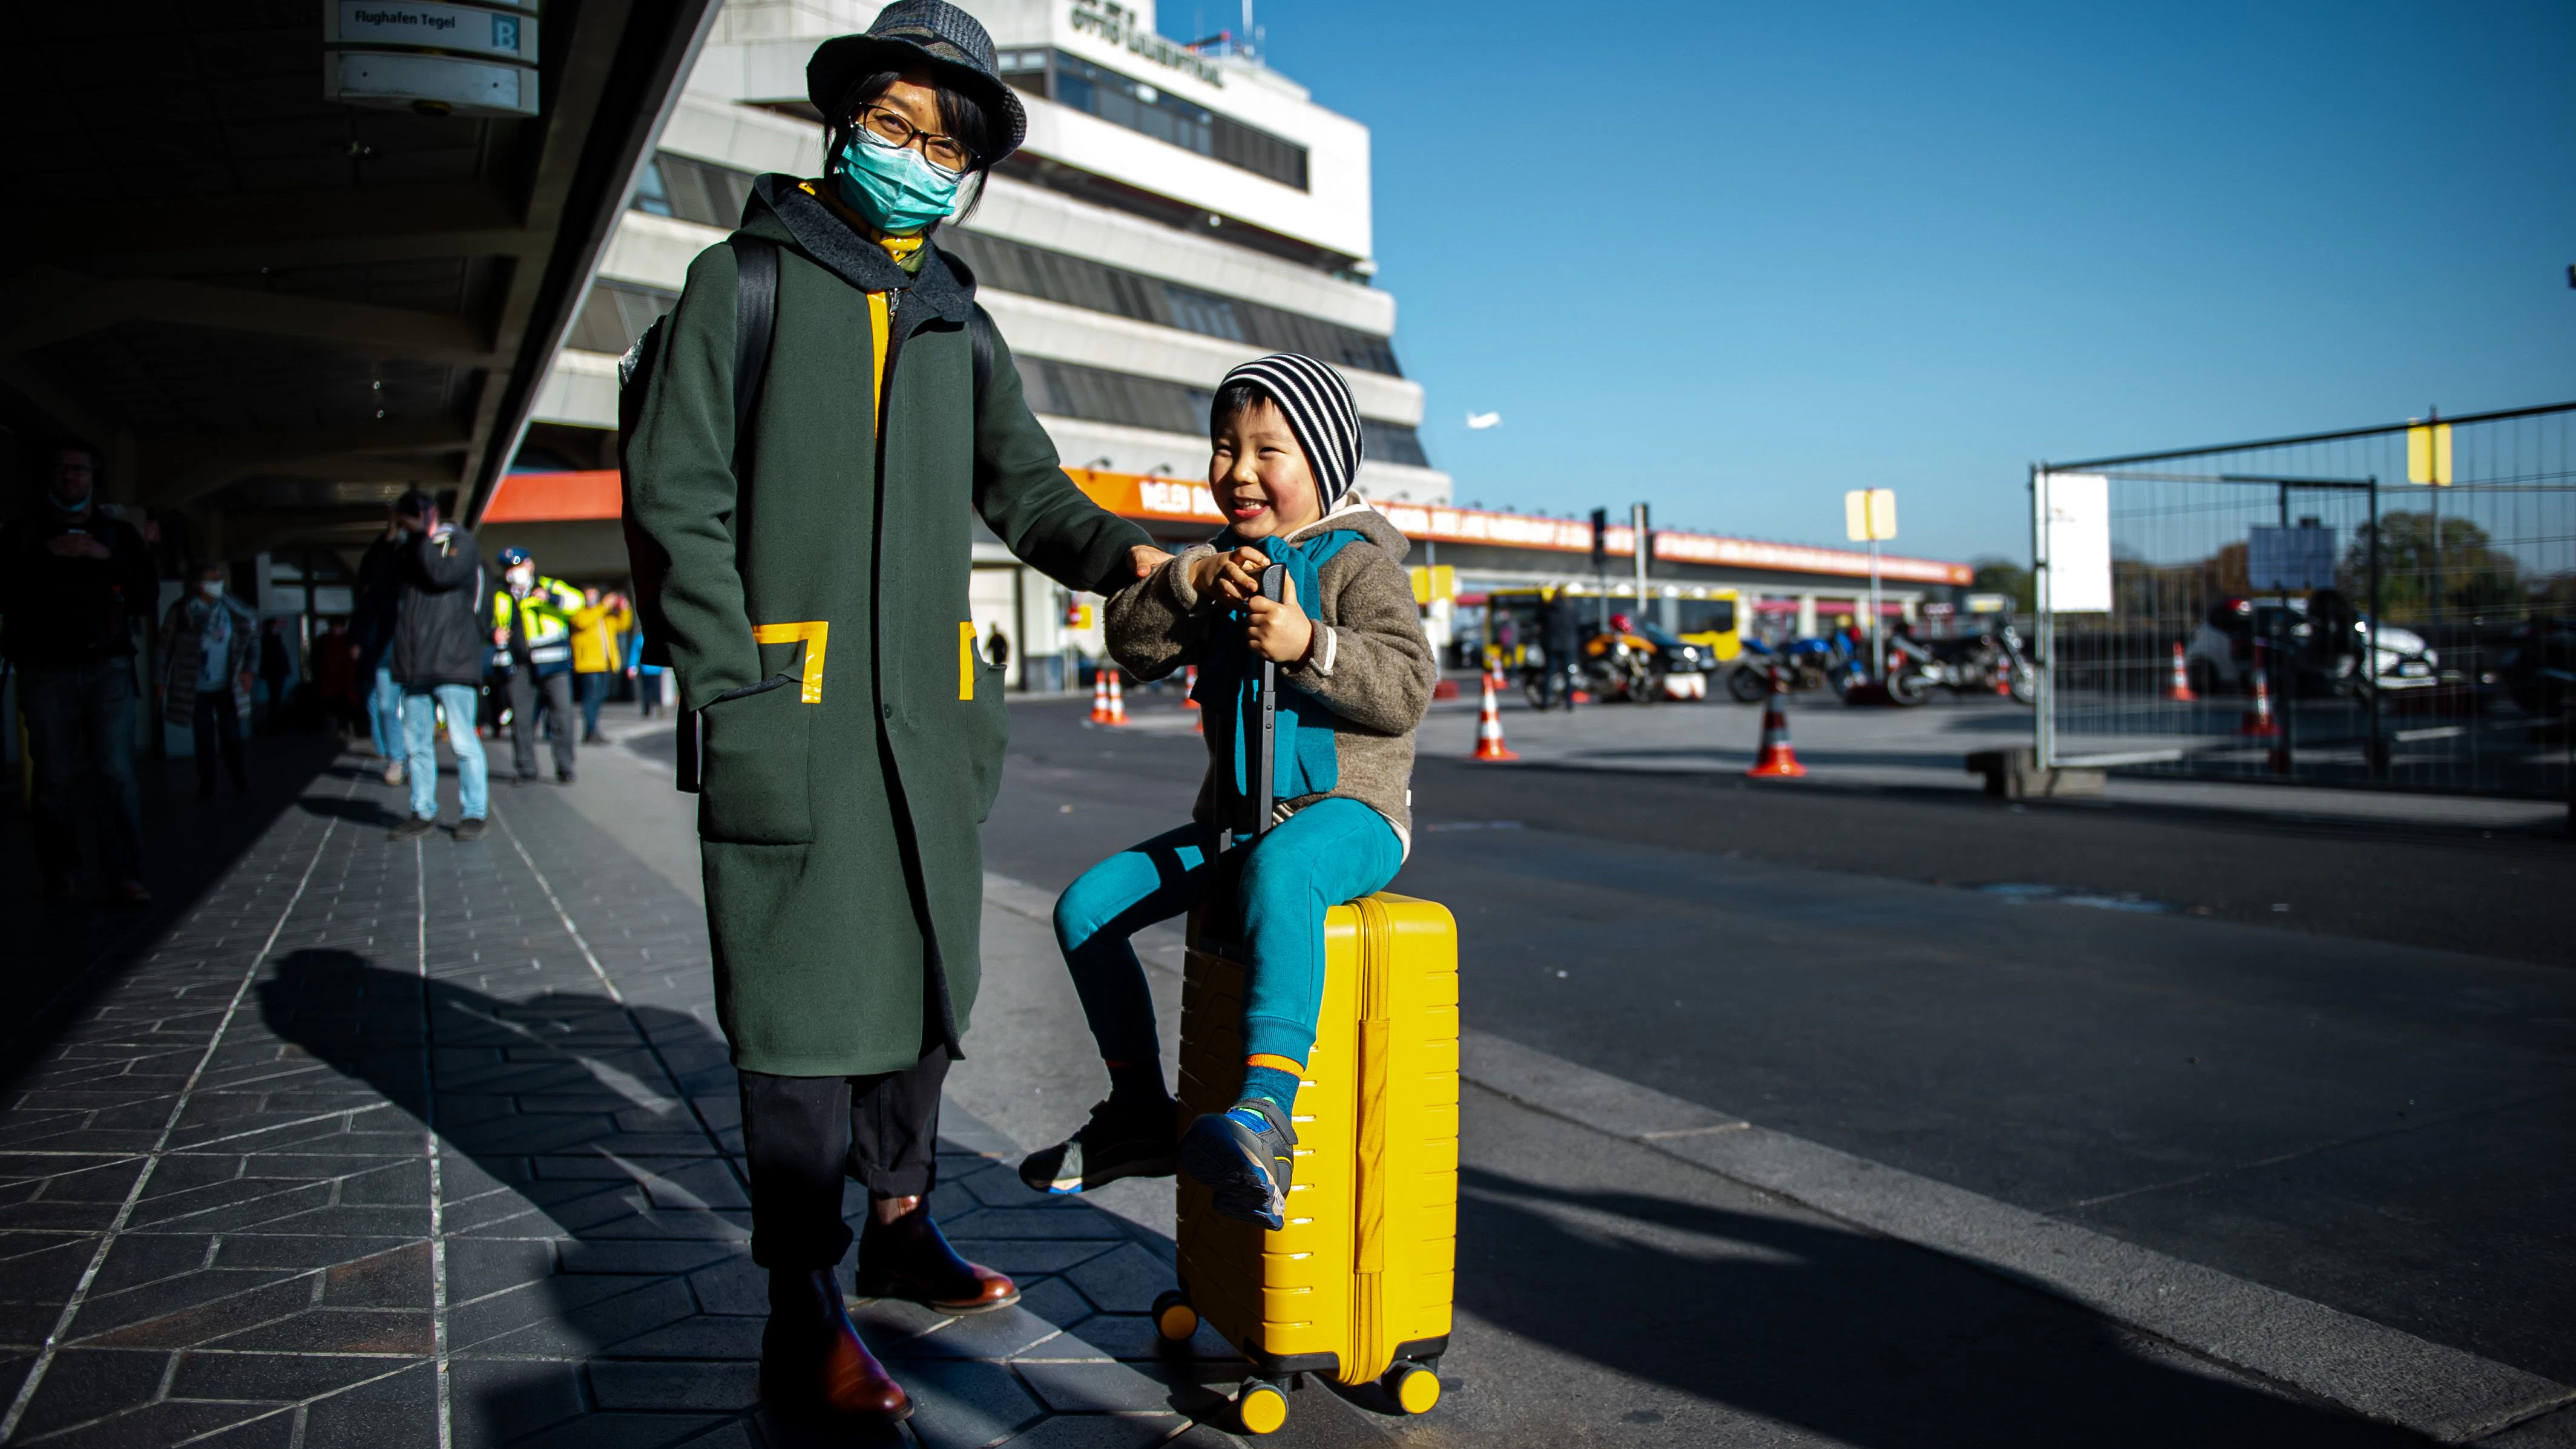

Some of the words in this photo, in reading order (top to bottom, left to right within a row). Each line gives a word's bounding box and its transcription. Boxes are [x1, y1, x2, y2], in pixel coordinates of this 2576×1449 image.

[355, 10, 418, 25] Flughafen
[421, 13, 455, 30] Tegel
[498, 21, 514, 50] B
